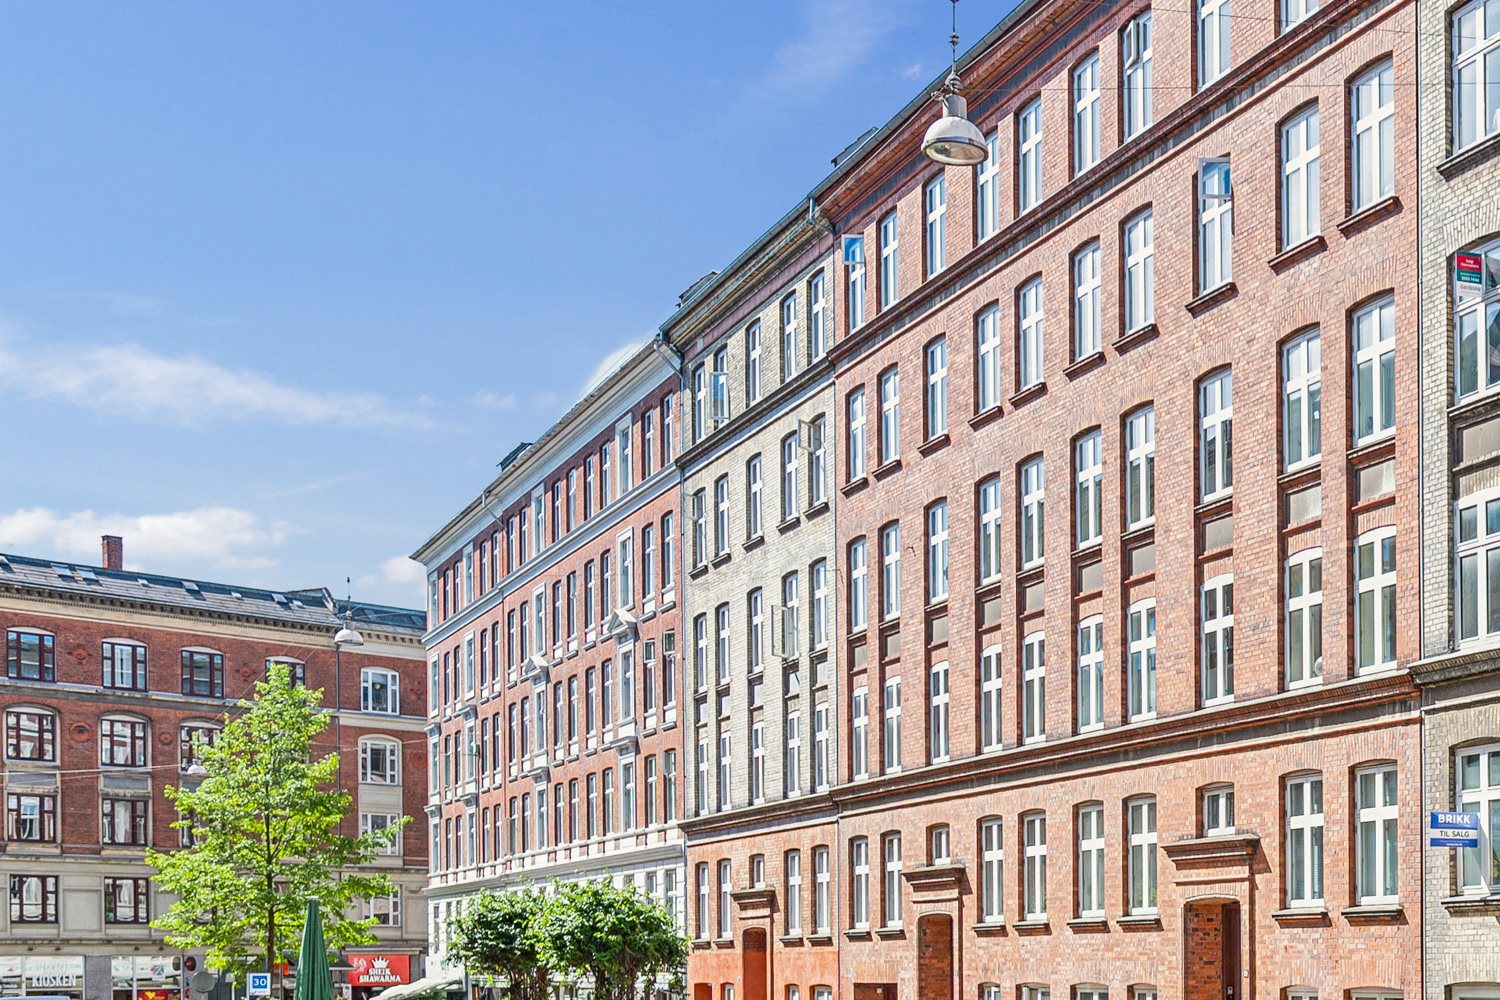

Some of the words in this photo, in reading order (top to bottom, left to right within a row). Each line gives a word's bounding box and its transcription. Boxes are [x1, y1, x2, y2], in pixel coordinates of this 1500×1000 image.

[1438, 814, 1471, 824] BRIKK
[368, 968, 392, 976] SHEIK
[32, 974, 77, 987] KIOSKEN
[253, 978, 267, 986] 30
[359, 974, 401, 983] SHAWARMA
